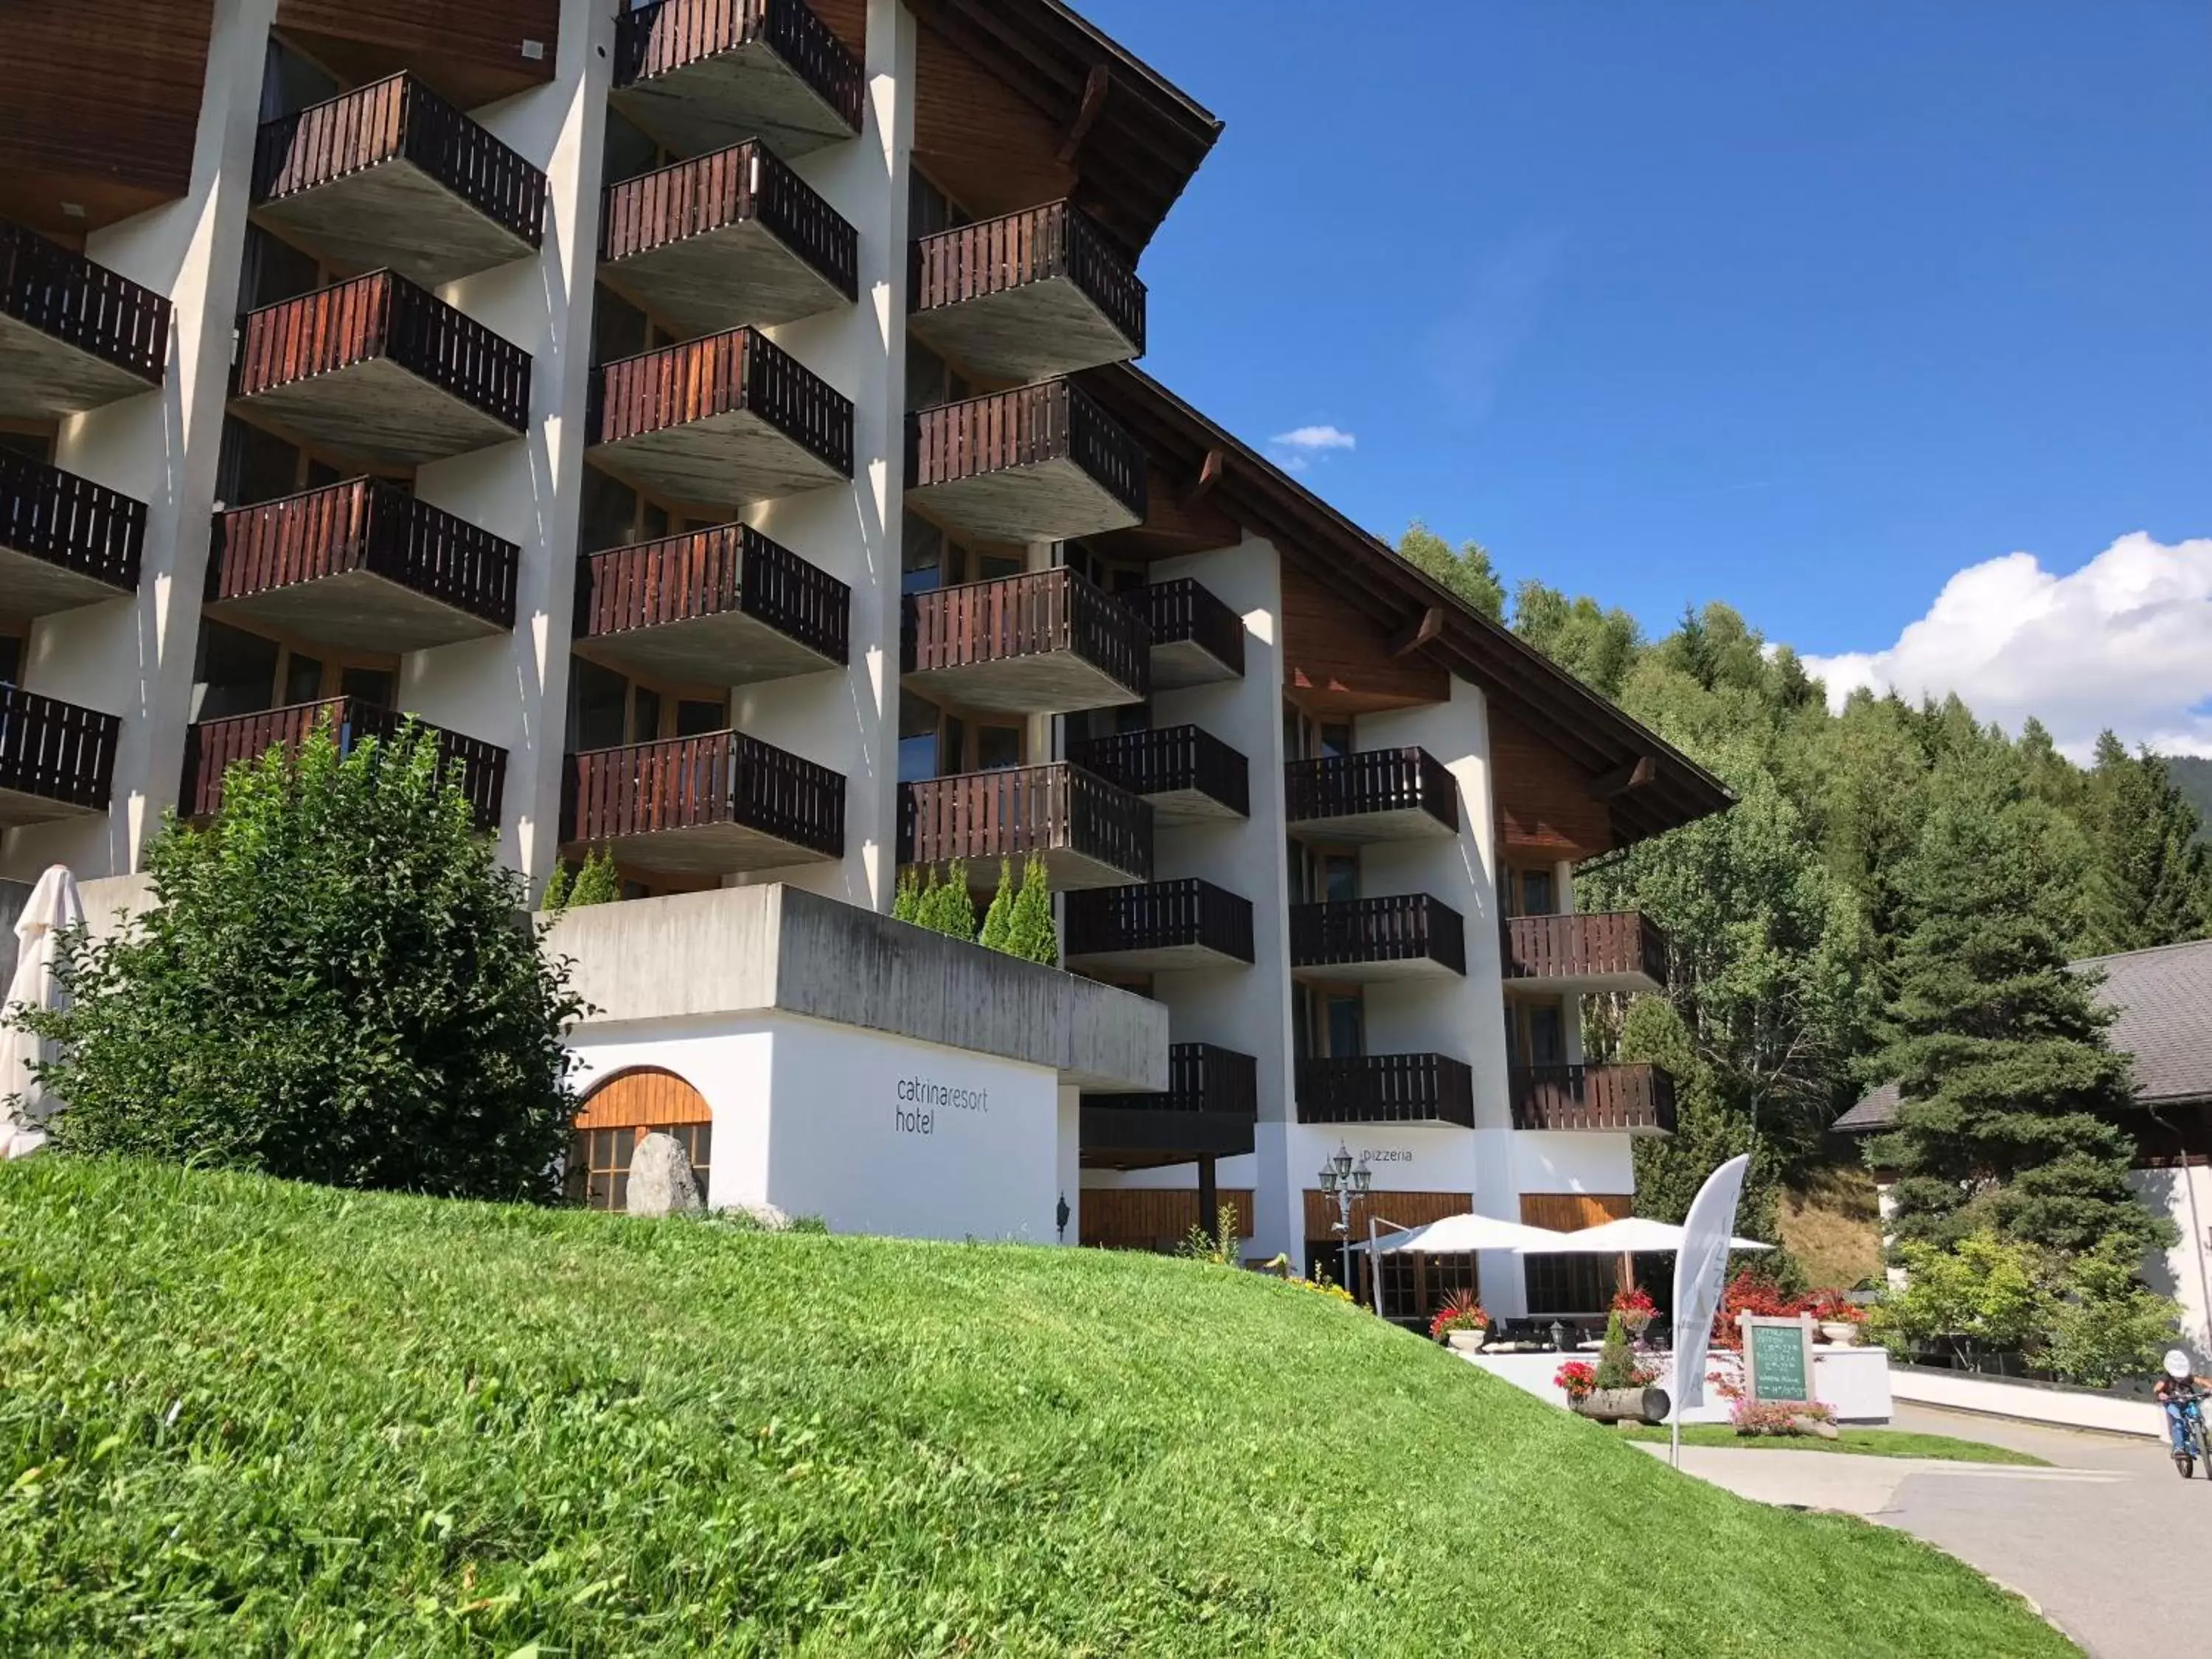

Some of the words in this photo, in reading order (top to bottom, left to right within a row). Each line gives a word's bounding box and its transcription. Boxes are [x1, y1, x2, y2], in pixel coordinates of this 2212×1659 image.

[897, 1076, 988, 1113] catrinaresort
[896, 1105, 934, 1134] hotel
[1363, 1148, 1412, 1163] pizzeria
